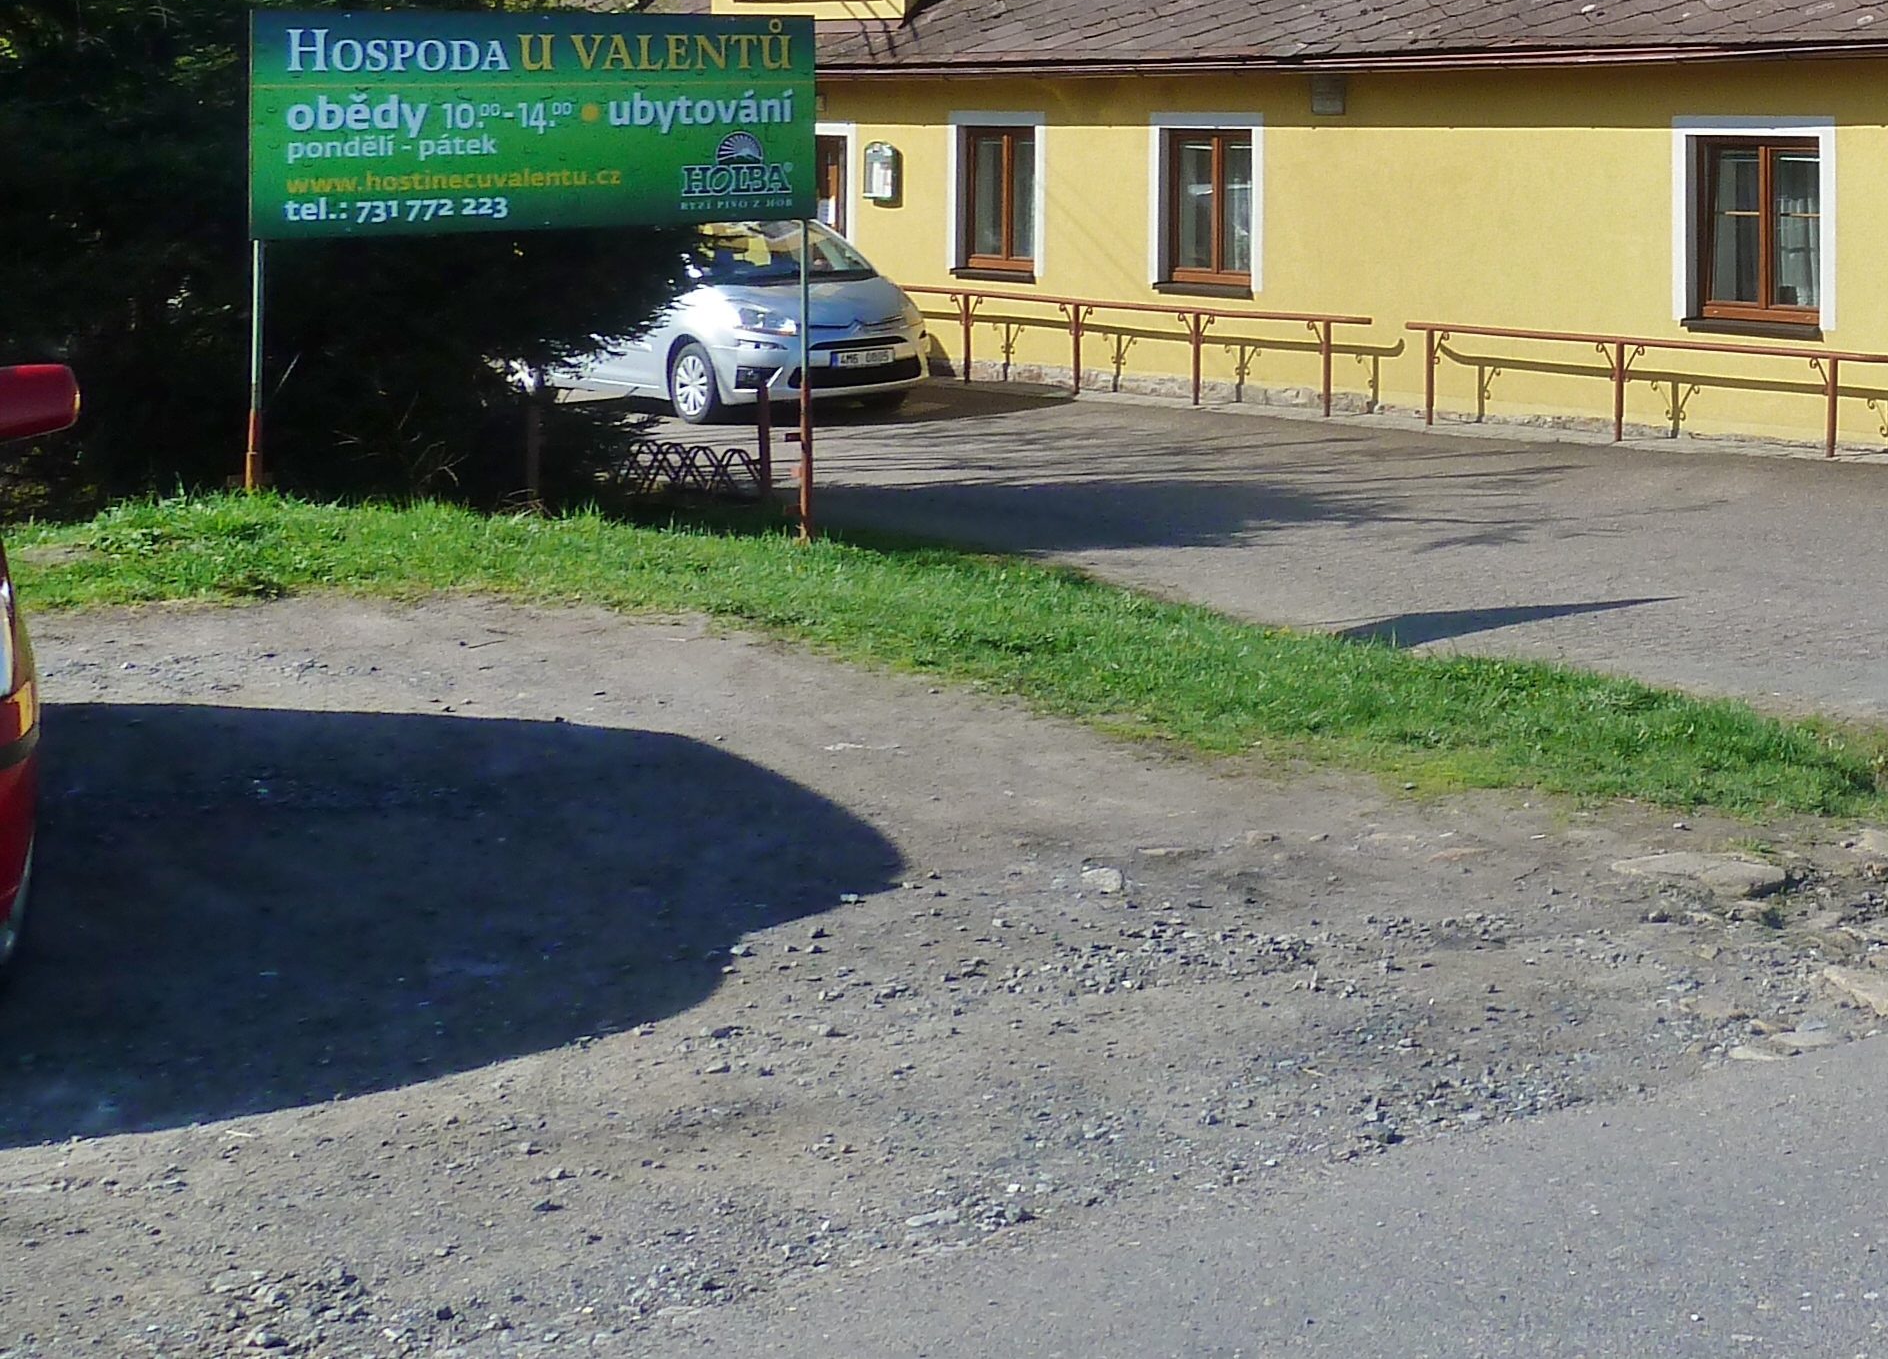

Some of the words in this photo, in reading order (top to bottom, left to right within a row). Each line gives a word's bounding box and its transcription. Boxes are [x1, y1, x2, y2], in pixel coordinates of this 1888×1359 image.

[517, 33, 554, 71] U
[571, 18, 792, 71] VALENTŮ
[286, 92, 429, 139] obědy
[608, 88, 794, 134] ubytování
[287, 134, 394, 164] pondělí
[418, 133, 498, 161] pátek
[286, 168, 622, 194] www.hostinecuvalentu.cz
[681, 163, 793, 197] HOLBA
[285, 196, 348, 222] tel.:
[356, 199, 400, 223] 731
[405, 198, 455, 222] 772
[461, 196, 509, 219] 223
